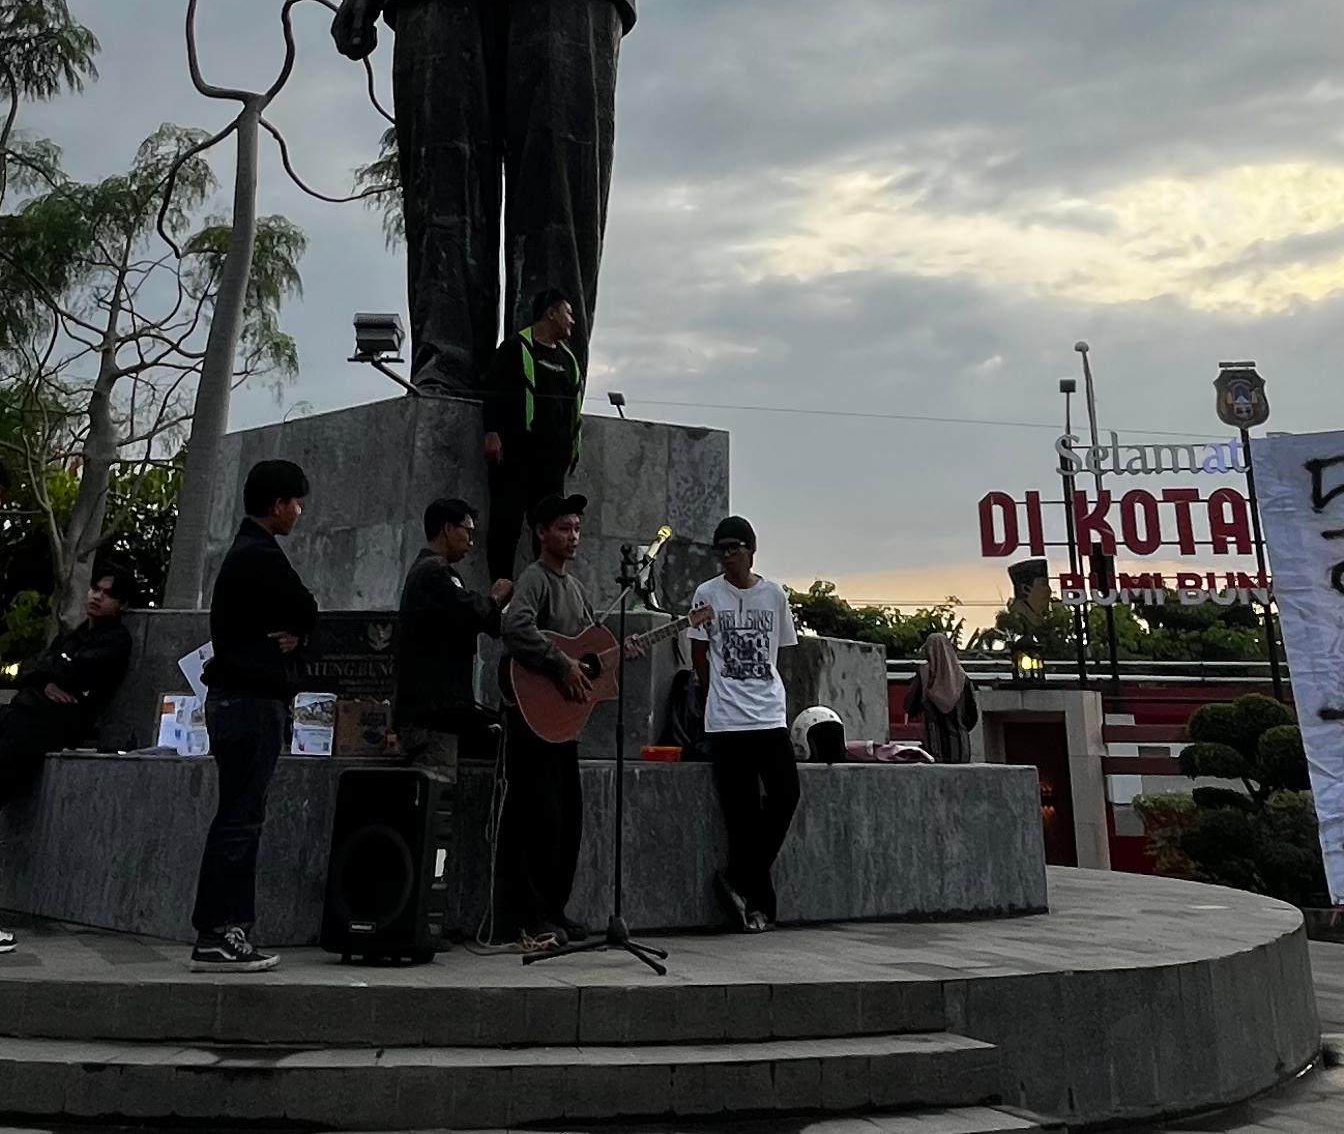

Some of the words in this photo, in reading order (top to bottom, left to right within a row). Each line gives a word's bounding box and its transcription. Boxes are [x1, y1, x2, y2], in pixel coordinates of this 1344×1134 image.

[1055, 431, 1250, 475] Selamat
[978, 489, 1046, 557] DI
[1072, 487, 1253, 556] KOTA
[1059, 572, 1166, 606] BUMI
